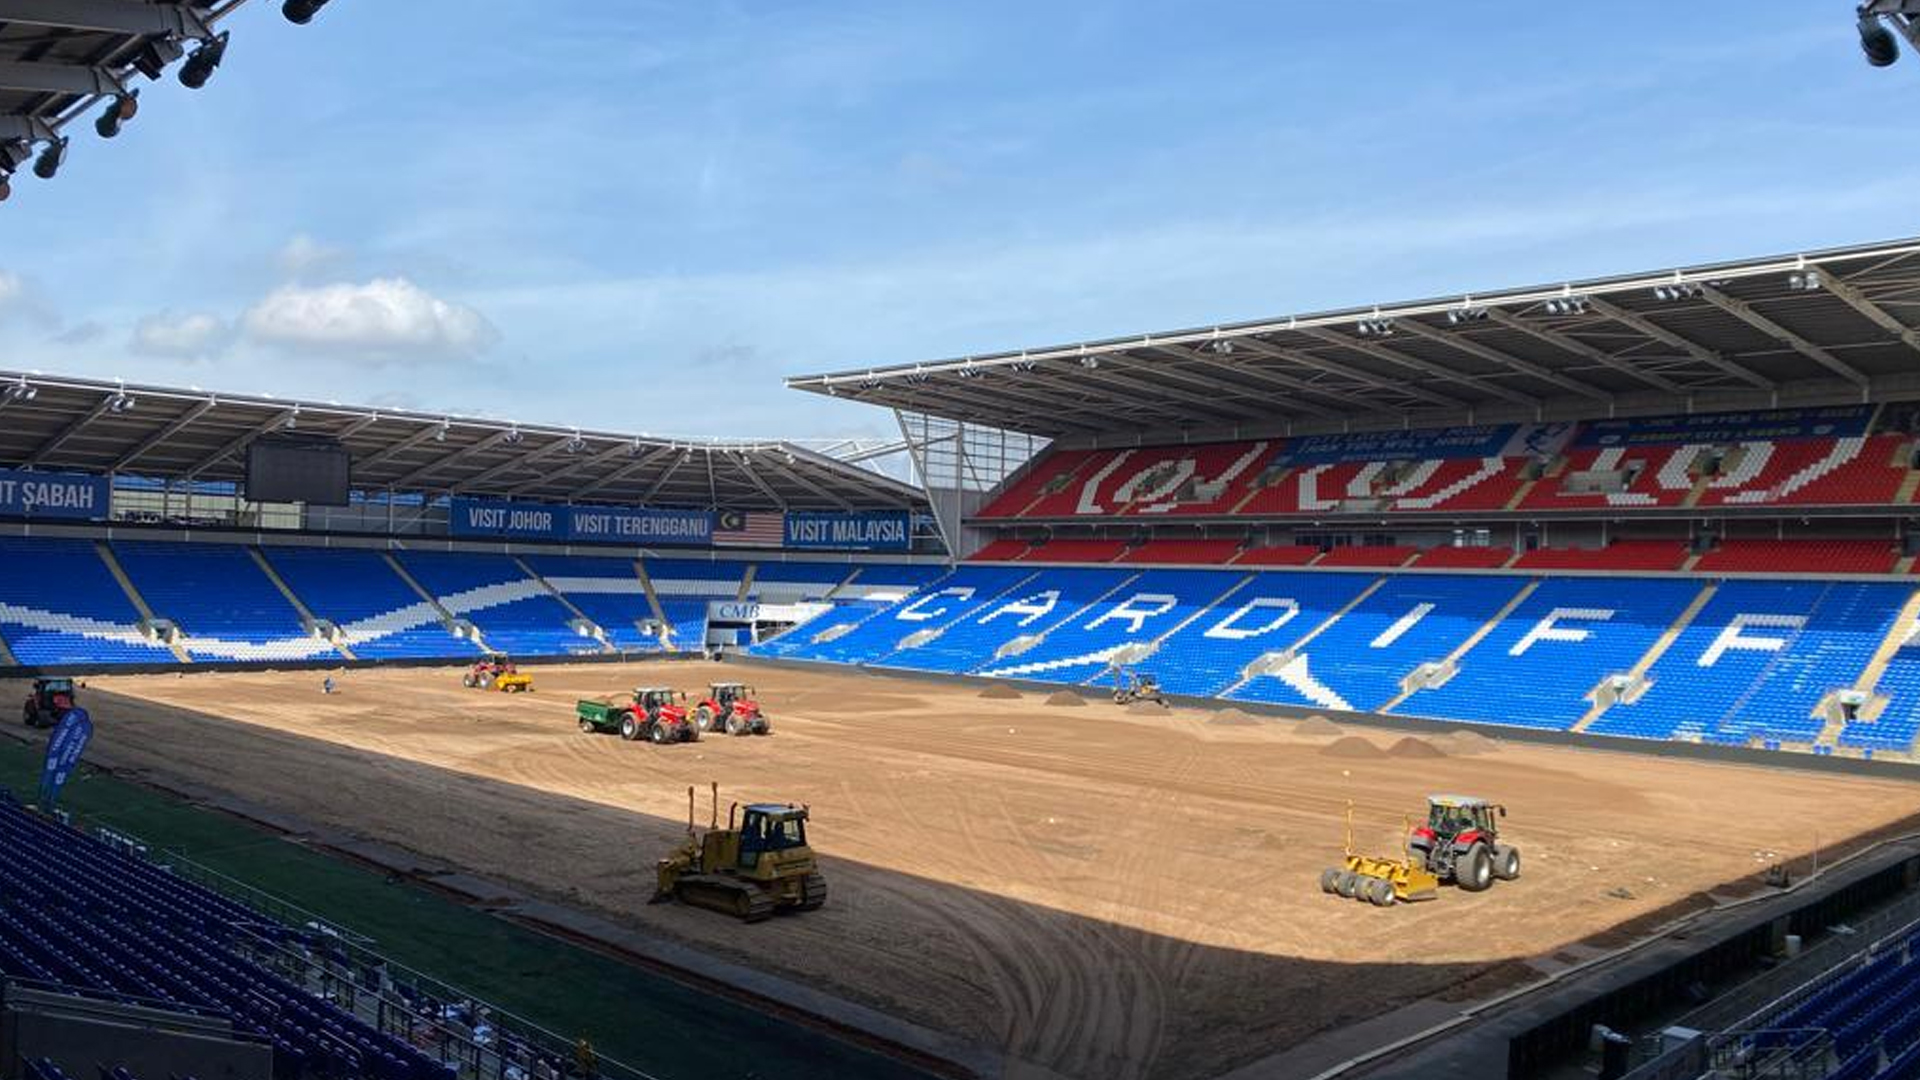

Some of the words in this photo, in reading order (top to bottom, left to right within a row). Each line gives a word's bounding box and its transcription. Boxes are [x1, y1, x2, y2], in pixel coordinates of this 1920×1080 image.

[22, 481, 94, 508] SABAH
[469, 508, 506, 528] VISIT
[508, 510, 552, 531] JOHOR
[575, 514, 611, 534] VISIT
[614, 516, 708, 537] TERENGGANU
[789, 520, 828, 542] VISIT
[832, 520, 906, 543] MALAYSIA
[719, 603, 760, 619] CMB
